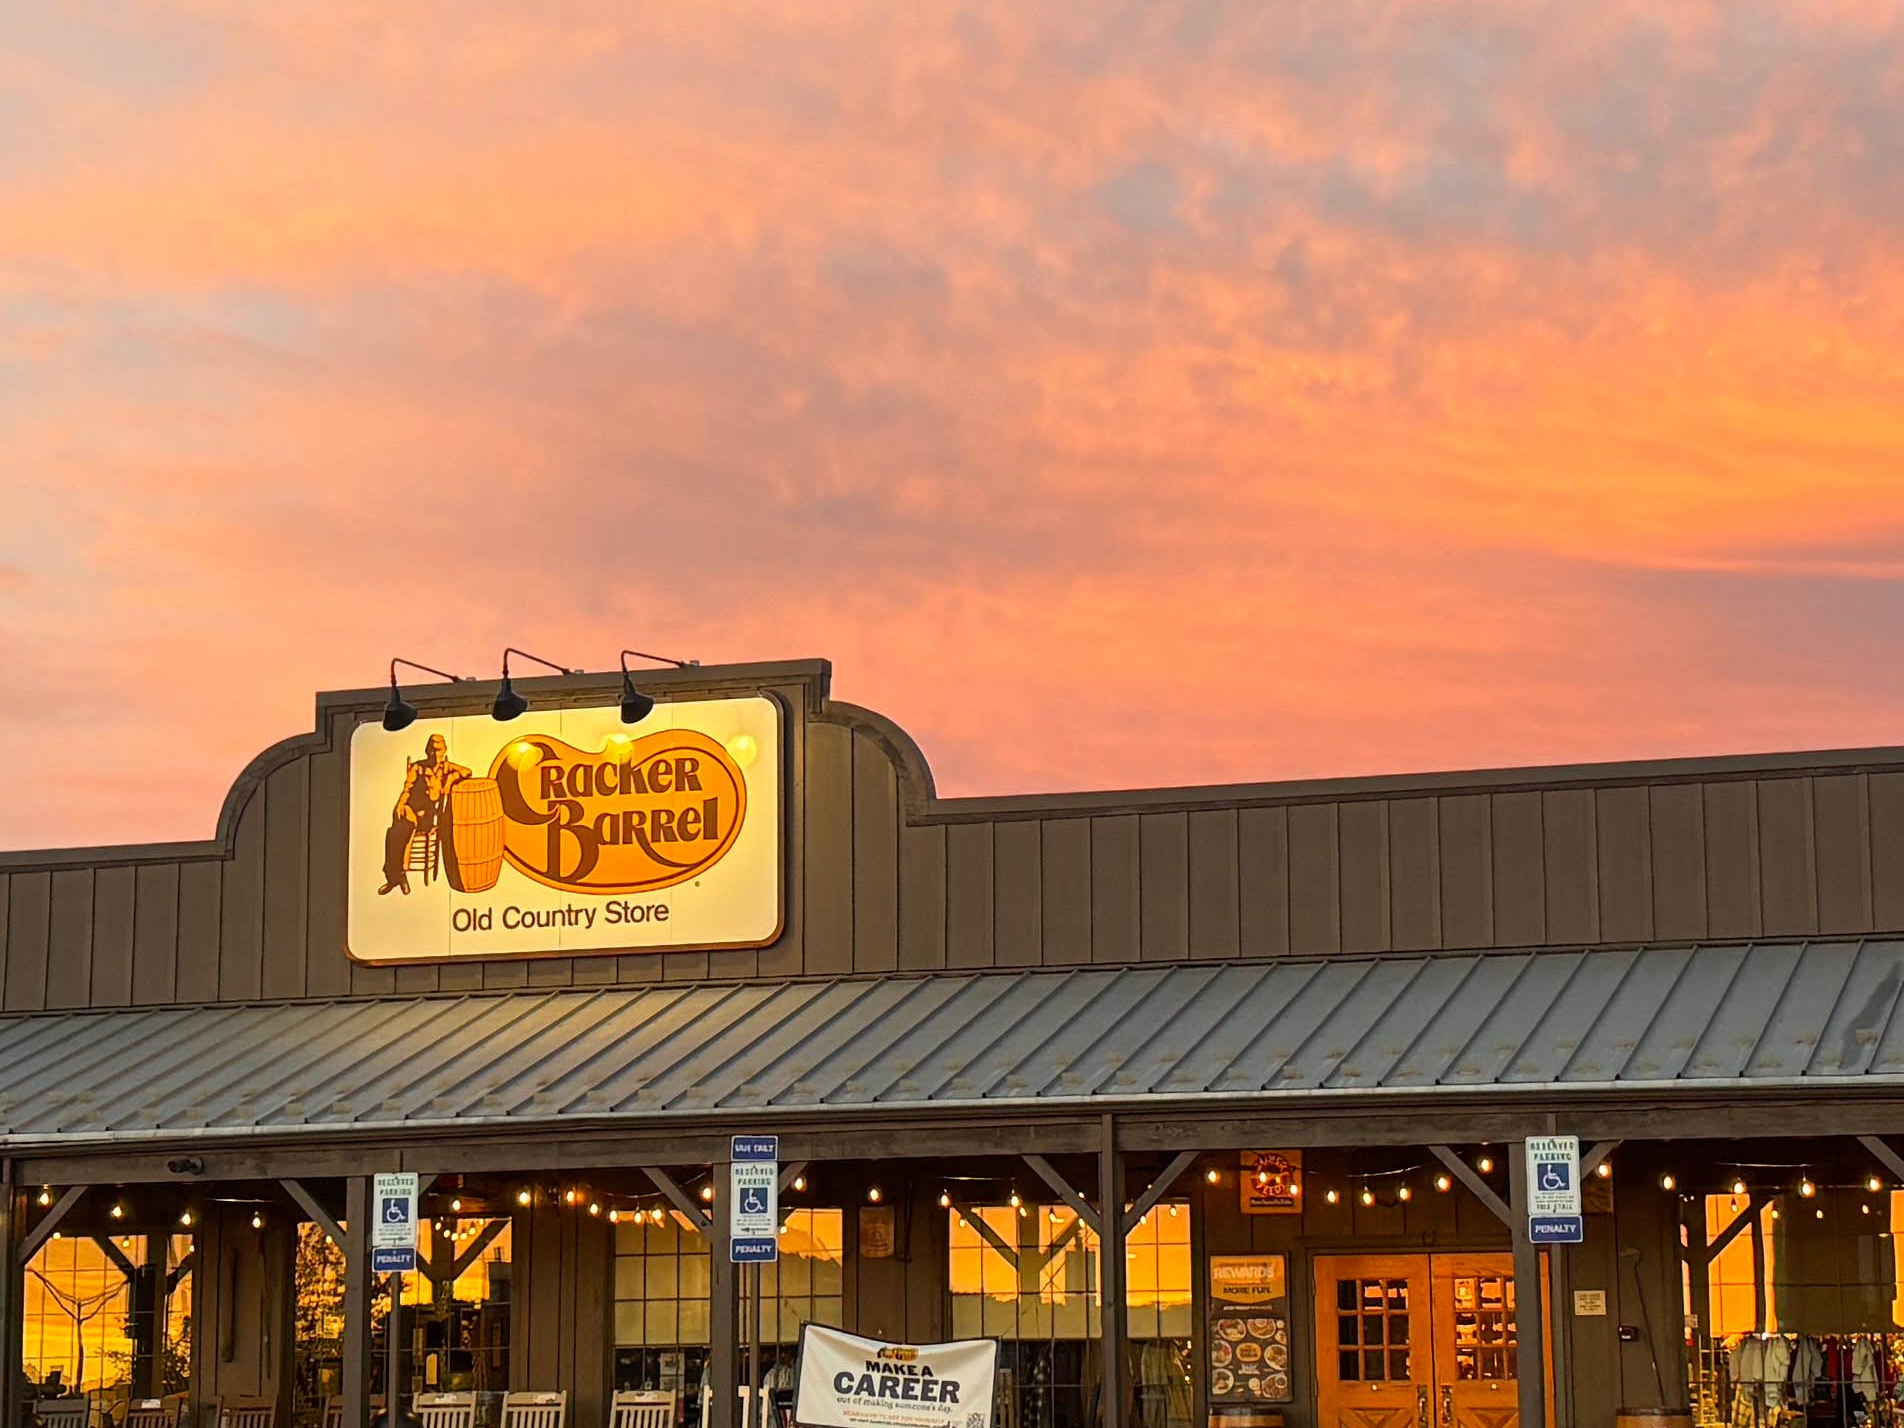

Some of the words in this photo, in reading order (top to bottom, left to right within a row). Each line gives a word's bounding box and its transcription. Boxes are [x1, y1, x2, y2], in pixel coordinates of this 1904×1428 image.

[546, 797, 718, 884] Barrel
[452, 907, 492, 932] Old
[502, 903, 597, 930] Country
[604, 900, 670, 924] Store
[1535, 1224, 1577, 1234] PENALTY
[735, 1245, 773, 1254] PENALTY
[376, 1255, 412, 1264] PENALTY
[1213, 1266, 1274, 1280] REWARDS
[865, 1360, 919, 1377] MAKE
[921, 1365, 934, 1377] A
[833, 1371, 961, 1404] CAREER
